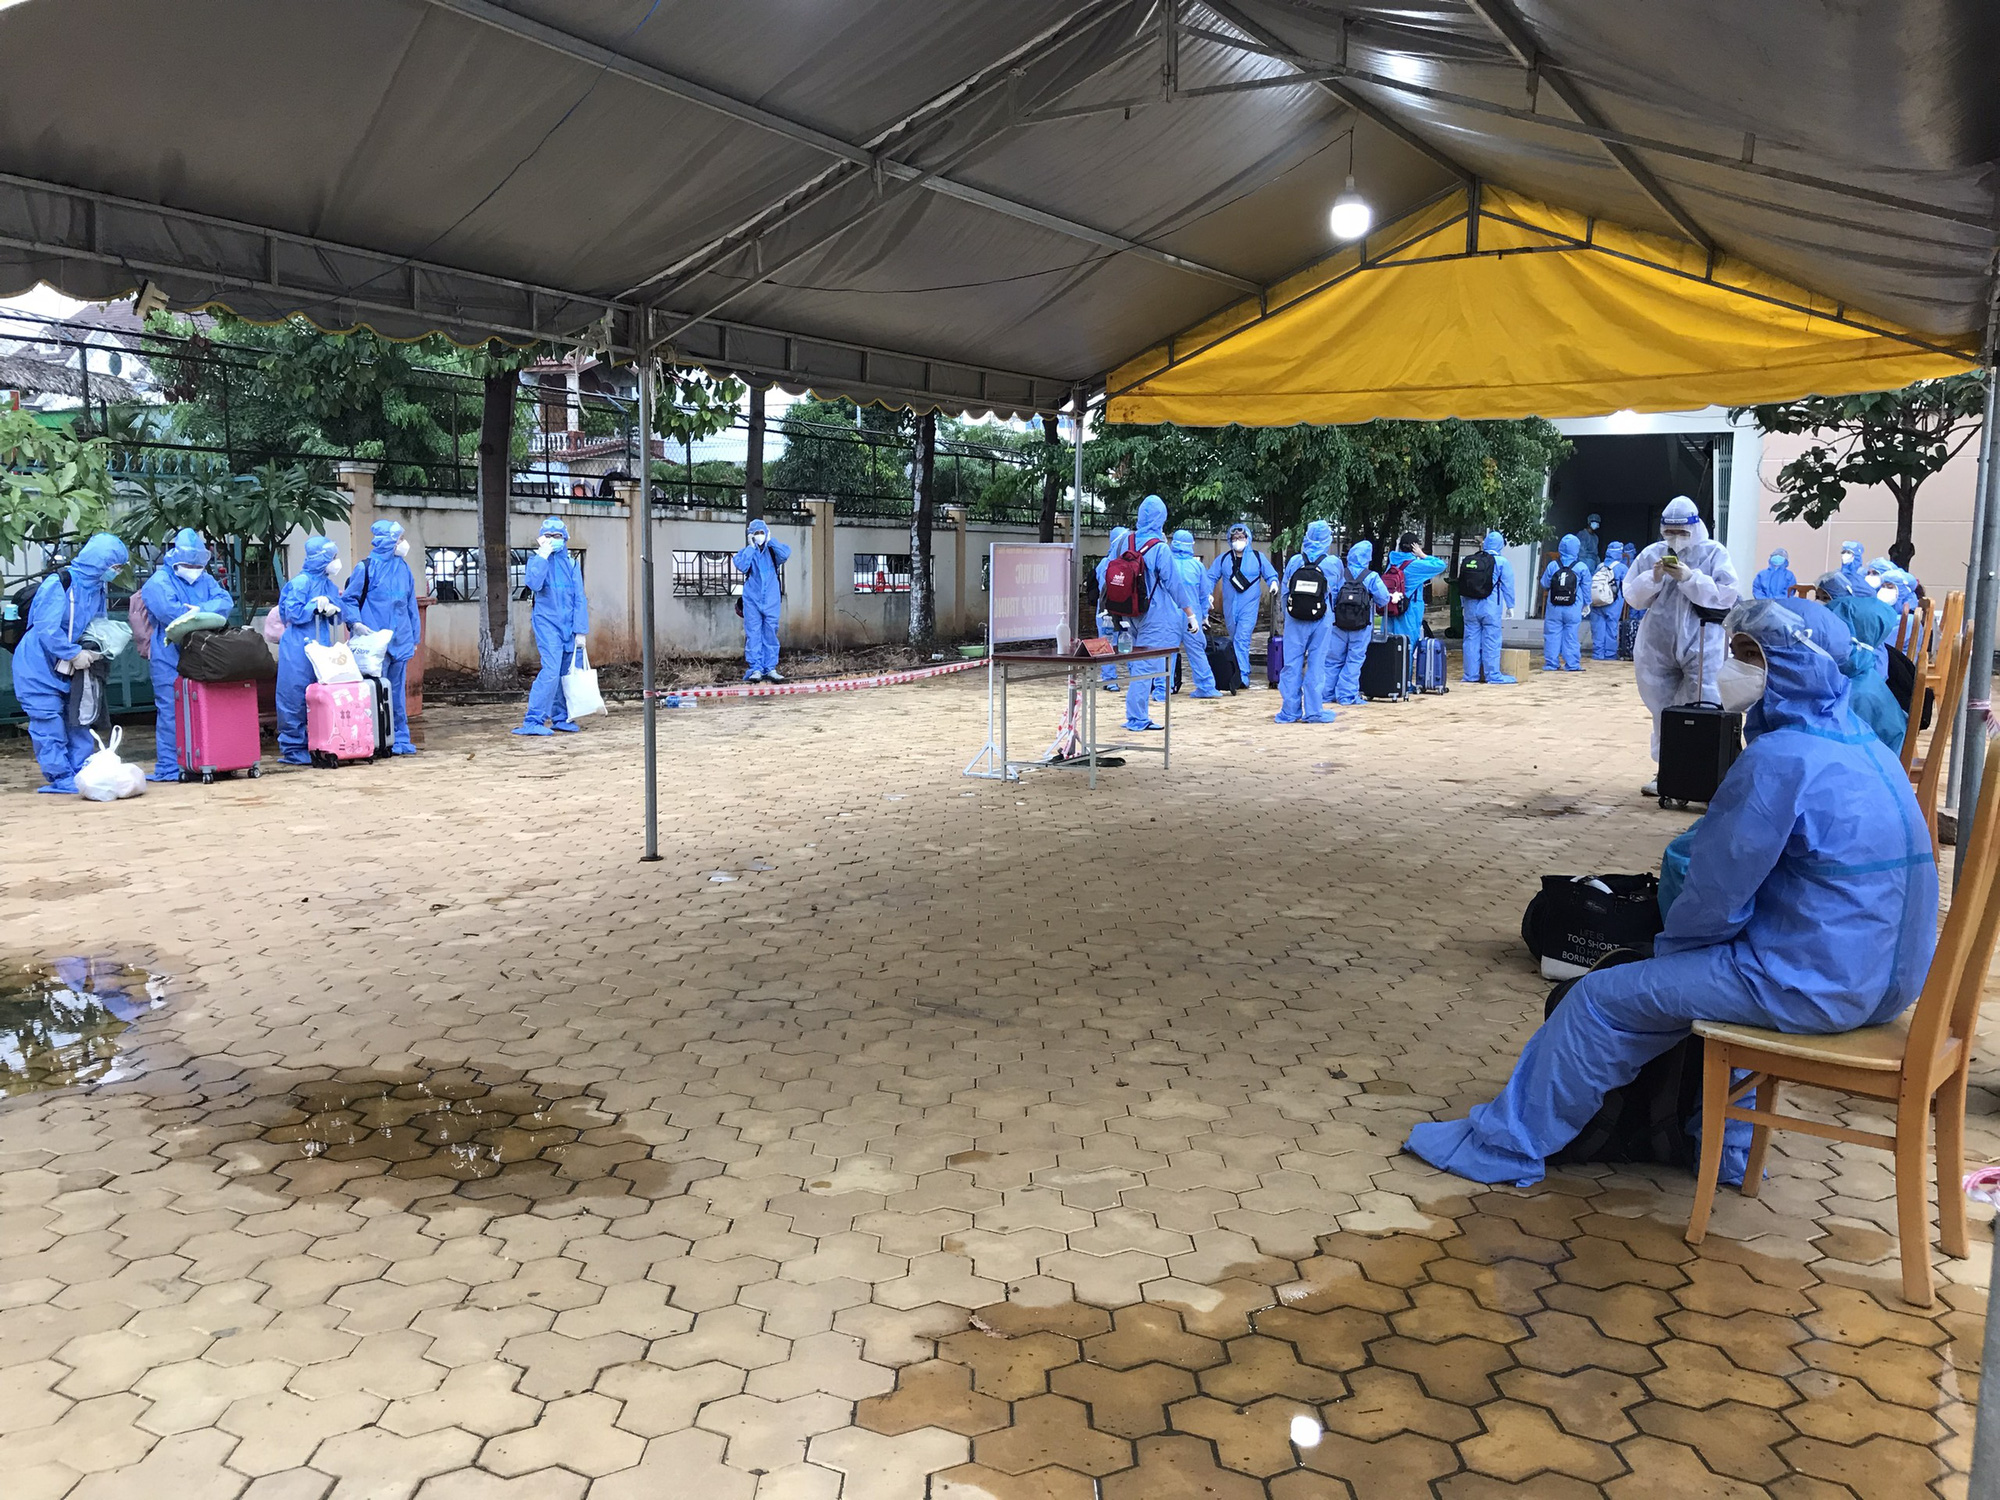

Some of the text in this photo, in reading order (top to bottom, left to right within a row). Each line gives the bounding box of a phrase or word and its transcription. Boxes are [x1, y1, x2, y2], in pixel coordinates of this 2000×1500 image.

[1579, 928, 1605, 941] LIFE IS
[1567, 933, 1620, 951] TOO SHORT
[1575, 945, 1586, 955] TO
[1561, 950, 1597, 966] BORING
